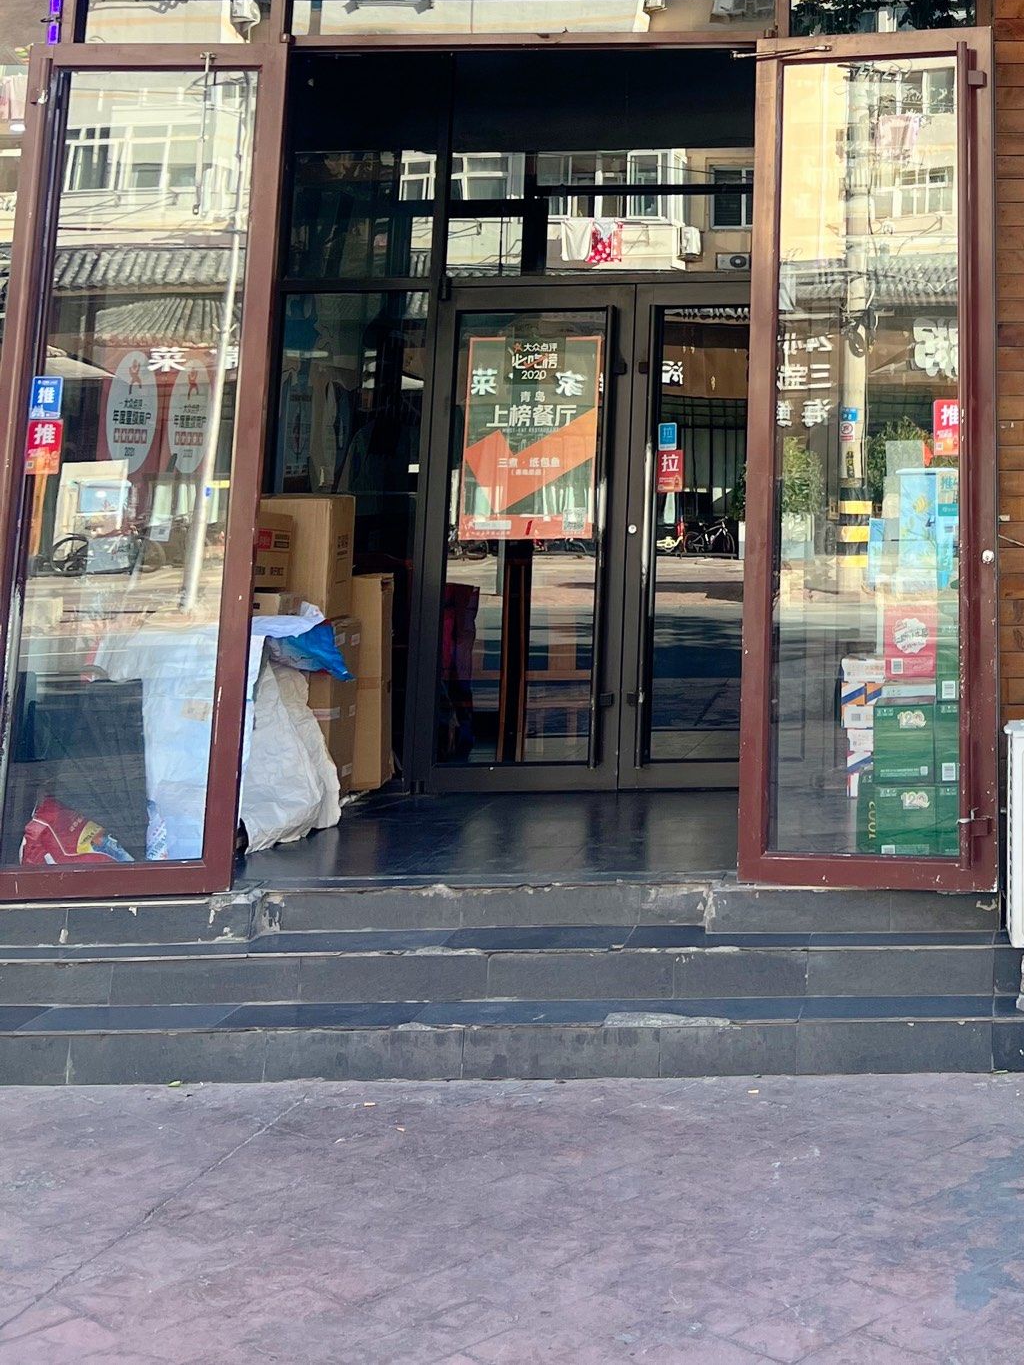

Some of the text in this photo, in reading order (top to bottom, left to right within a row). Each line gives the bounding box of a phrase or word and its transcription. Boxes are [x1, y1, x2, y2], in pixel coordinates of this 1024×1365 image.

[523, 342, 558, 352] 大众点评
[521, 370, 547, 380] 2020
[37, 386, 56, 404] 推
[520, 391, 546, 402] 青岛
[486, 404, 577, 428] 上榜餐厅
[34, 423, 56, 445] 推
[662, 454, 680, 472] 拉
